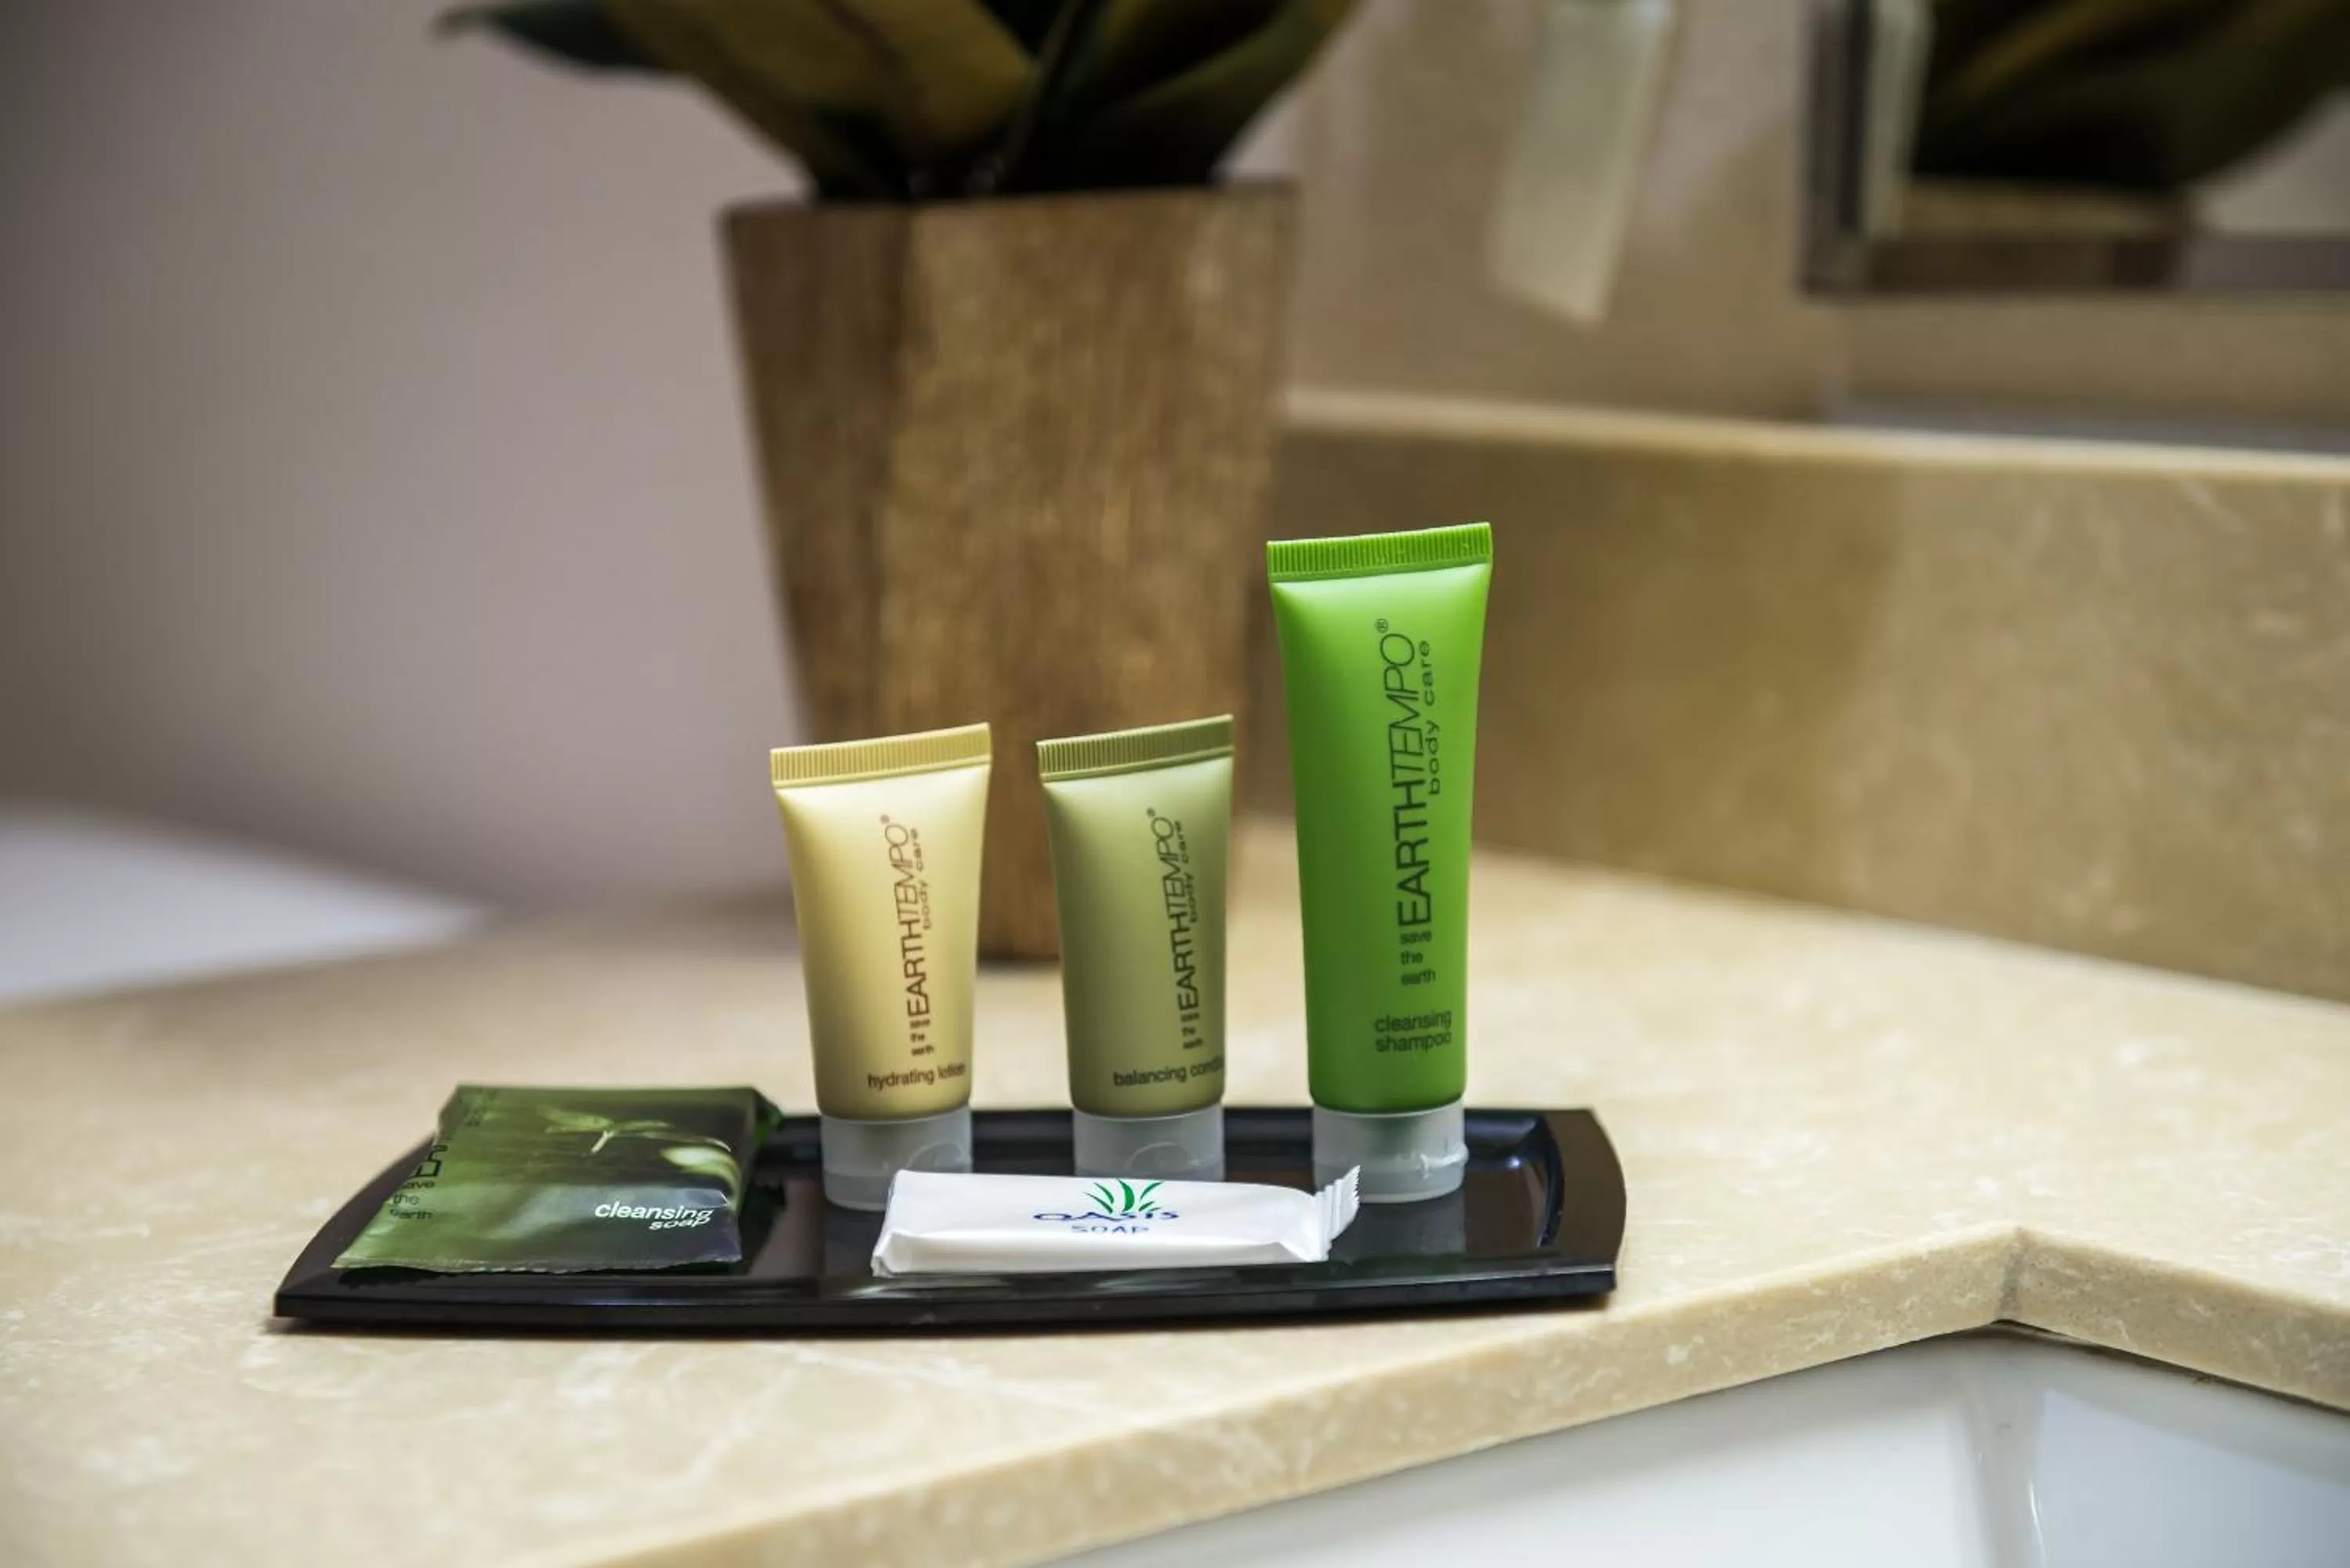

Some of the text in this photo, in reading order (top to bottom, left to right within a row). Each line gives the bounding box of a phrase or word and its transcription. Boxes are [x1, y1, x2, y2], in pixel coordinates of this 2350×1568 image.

[1419, 640, 1440, 796] body care
[909, 828, 932, 930] body care
[1401, 951, 1423, 965] the
[1374, 1009, 1452, 1033] cleansing
[1376, 1031, 1452, 1053] shampoo
[866, 1066, 935, 1092] hydrating
[1112, 1066, 1188, 1086] balancing
[595, 1201, 714, 1224] cleansing
[649, 1216, 712, 1230] soap
[1032, 1210, 1179, 1223] OASIS
[1071, 1225, 1150, 1234] SOAP
